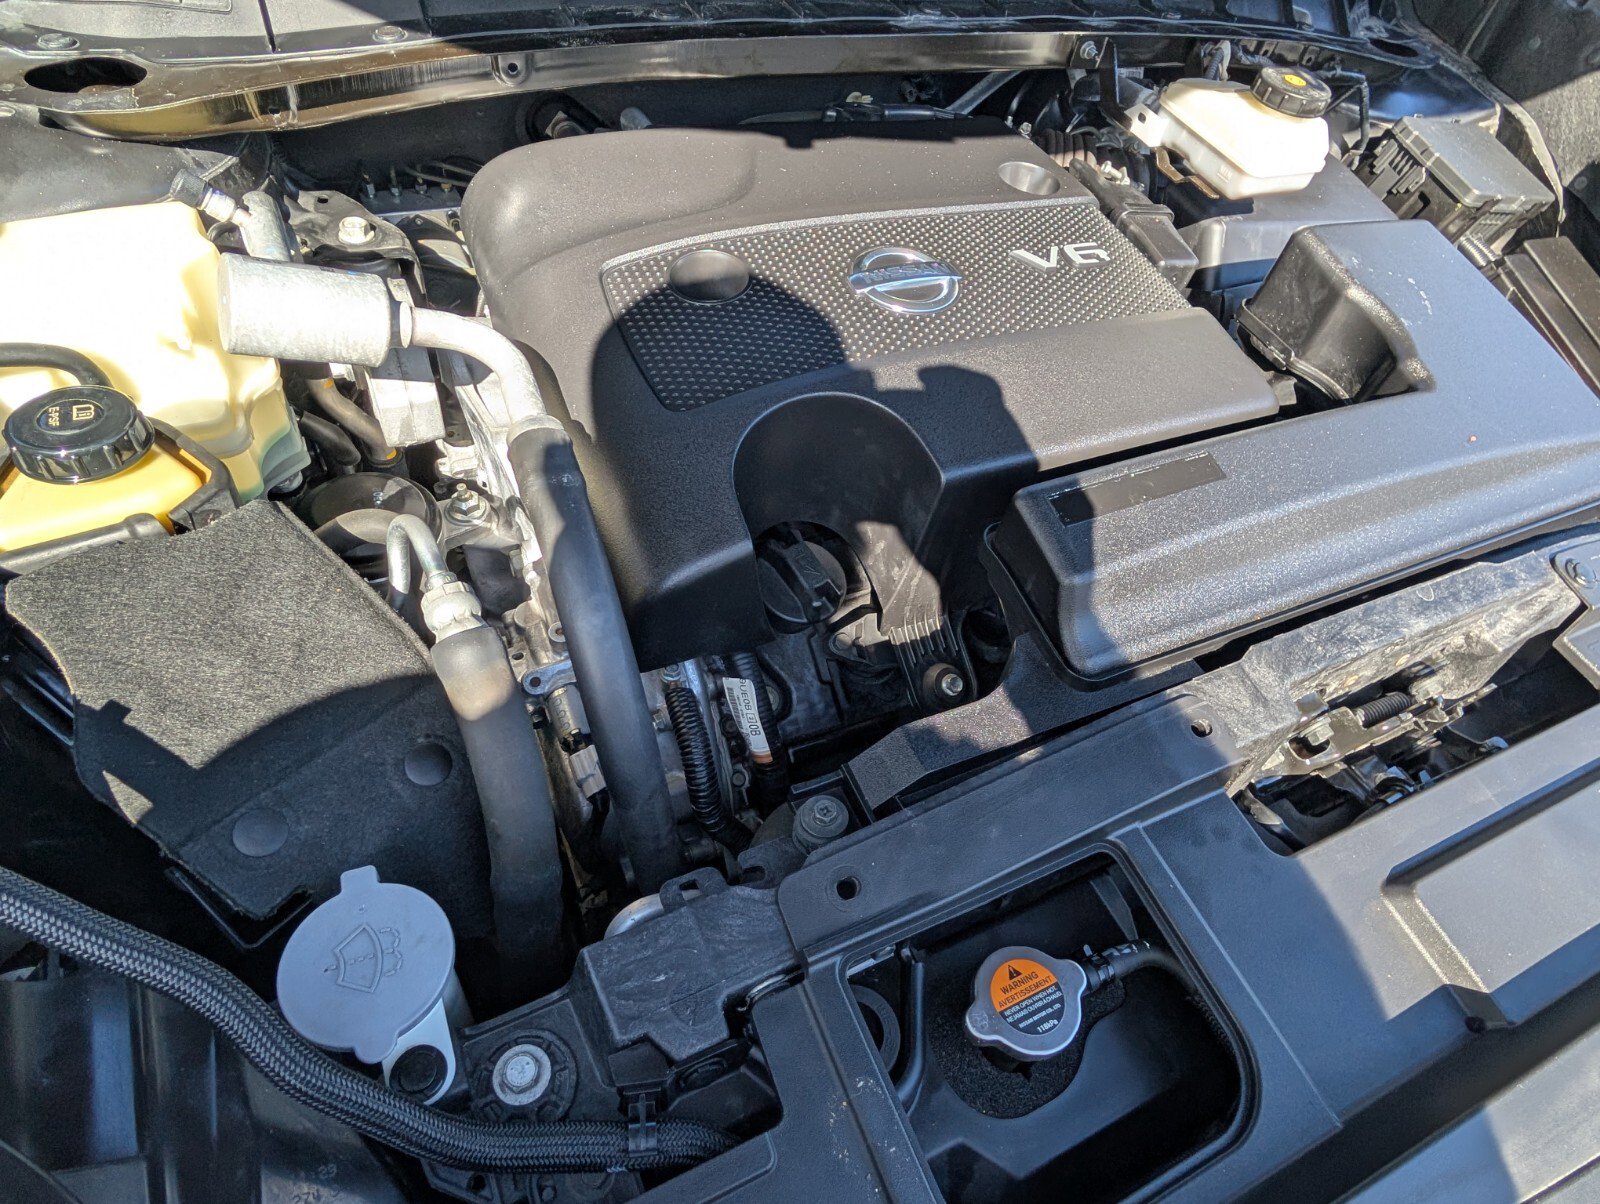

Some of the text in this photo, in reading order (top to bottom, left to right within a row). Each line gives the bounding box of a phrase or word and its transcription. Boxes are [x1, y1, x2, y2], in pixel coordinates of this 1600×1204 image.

[1009, 242, 1111, 273] V6
[863, 262, 948, 284] NISSAN
[998, 975, 1052, 1008] AVERTISSEMENT
[1000, 971, 1039, 995] WARNING
[1004, 1004, 1020, 1016] NEVER
[1020, 998, 1034, 1008] OPEN
[1032, 990, 1047, 1002] WHEN
[1037, 1018, 1059, 1033] 118kPa
